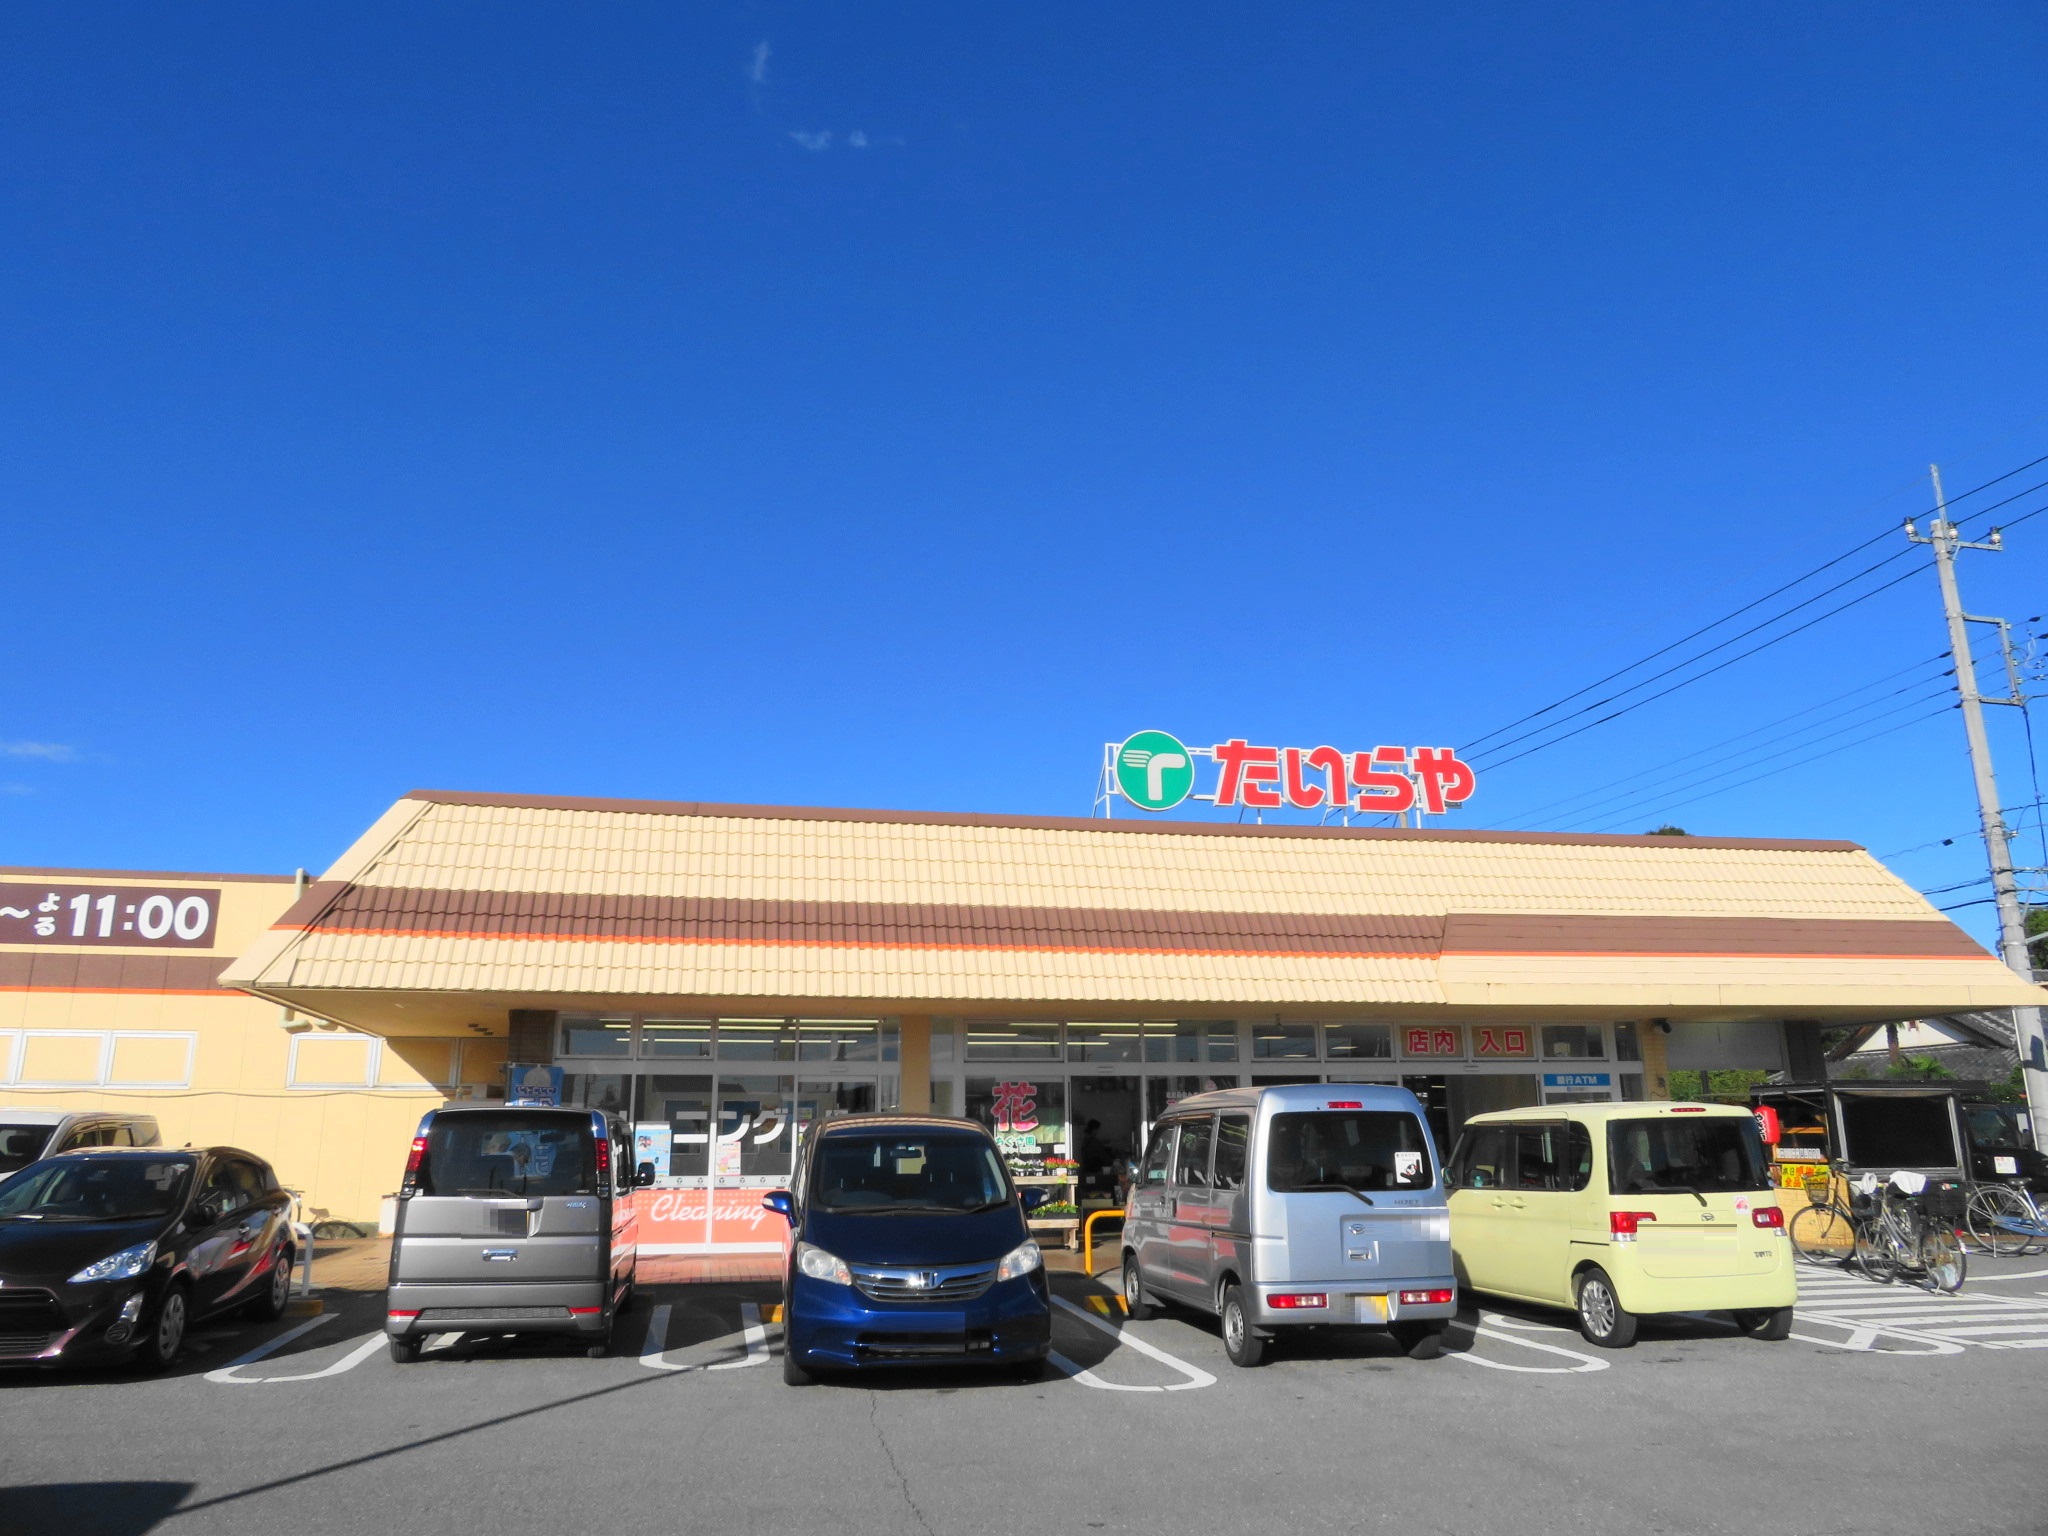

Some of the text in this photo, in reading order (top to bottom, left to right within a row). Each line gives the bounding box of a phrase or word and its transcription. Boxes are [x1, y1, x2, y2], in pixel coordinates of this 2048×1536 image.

[1212, 738, 1476, 815] たいらや
[69, 893, 210, 941] 11:00
[1408, 1029, 1527, 1053] 店内 入口
[618, 1108, 789, 1145] ニング
[990, 1081, 1039, 1132] 花
[651, 1194, 767, 1231] Cleaning
